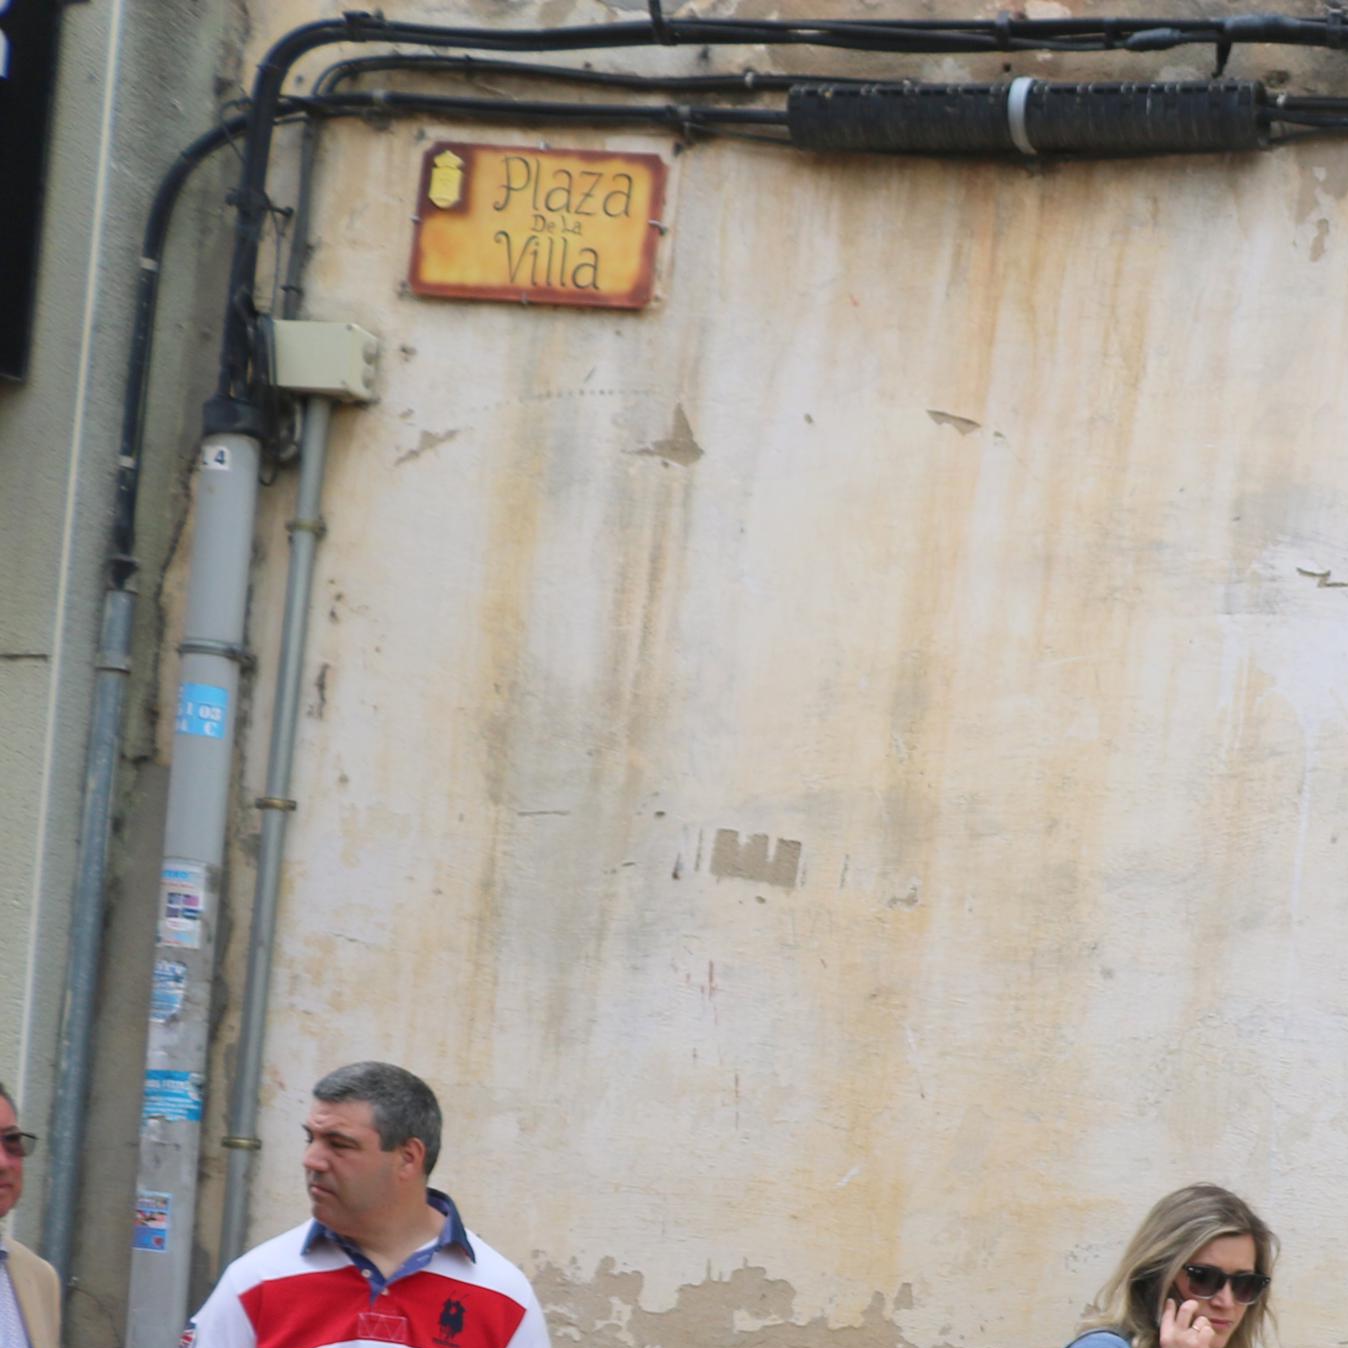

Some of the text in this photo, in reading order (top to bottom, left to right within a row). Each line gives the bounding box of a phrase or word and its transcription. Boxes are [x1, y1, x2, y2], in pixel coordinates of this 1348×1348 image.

[493, 155, 632, 217] Plaza
[531, 214, 583, 236] De La
[494, 230, 600, 289] Villa
